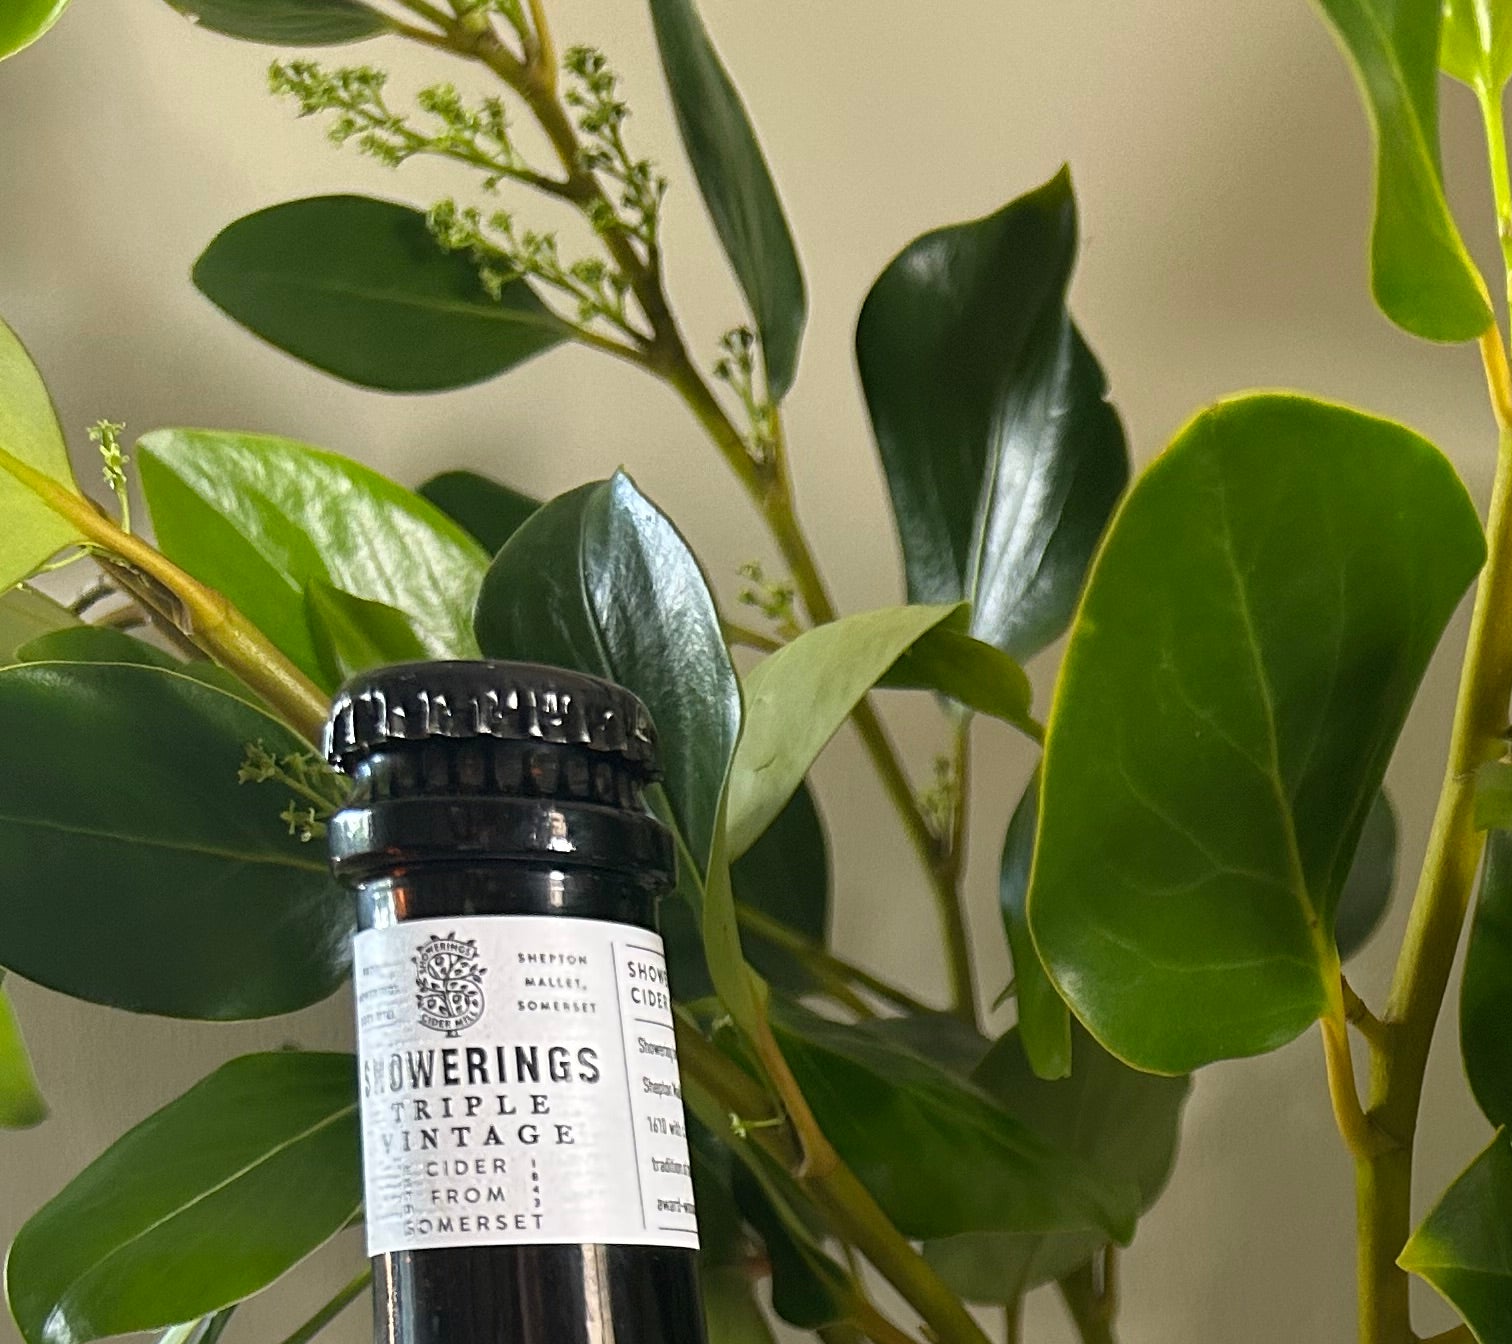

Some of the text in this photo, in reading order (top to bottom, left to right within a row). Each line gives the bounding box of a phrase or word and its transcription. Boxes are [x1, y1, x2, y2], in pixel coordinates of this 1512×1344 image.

[419, 942, 471, 974] SHOWERINGS
[517, 952, 588, 965] SHEPTON
[517, 1000, 597, 1013] SOMERSET
[421, 1010, 479, 1029] CIDER MILL
[364, 1046, 600, 1099] SHOWERINGS
[390, 1094, 551, 1124] TRIPLE
[381, 1124, 576, 1155] VINTAGE
[426, 1158, 507, 1177] CIDER
[431, 1186, 506, 1205] FROM
[404, 1214, 543, 1236] SOMERSET
